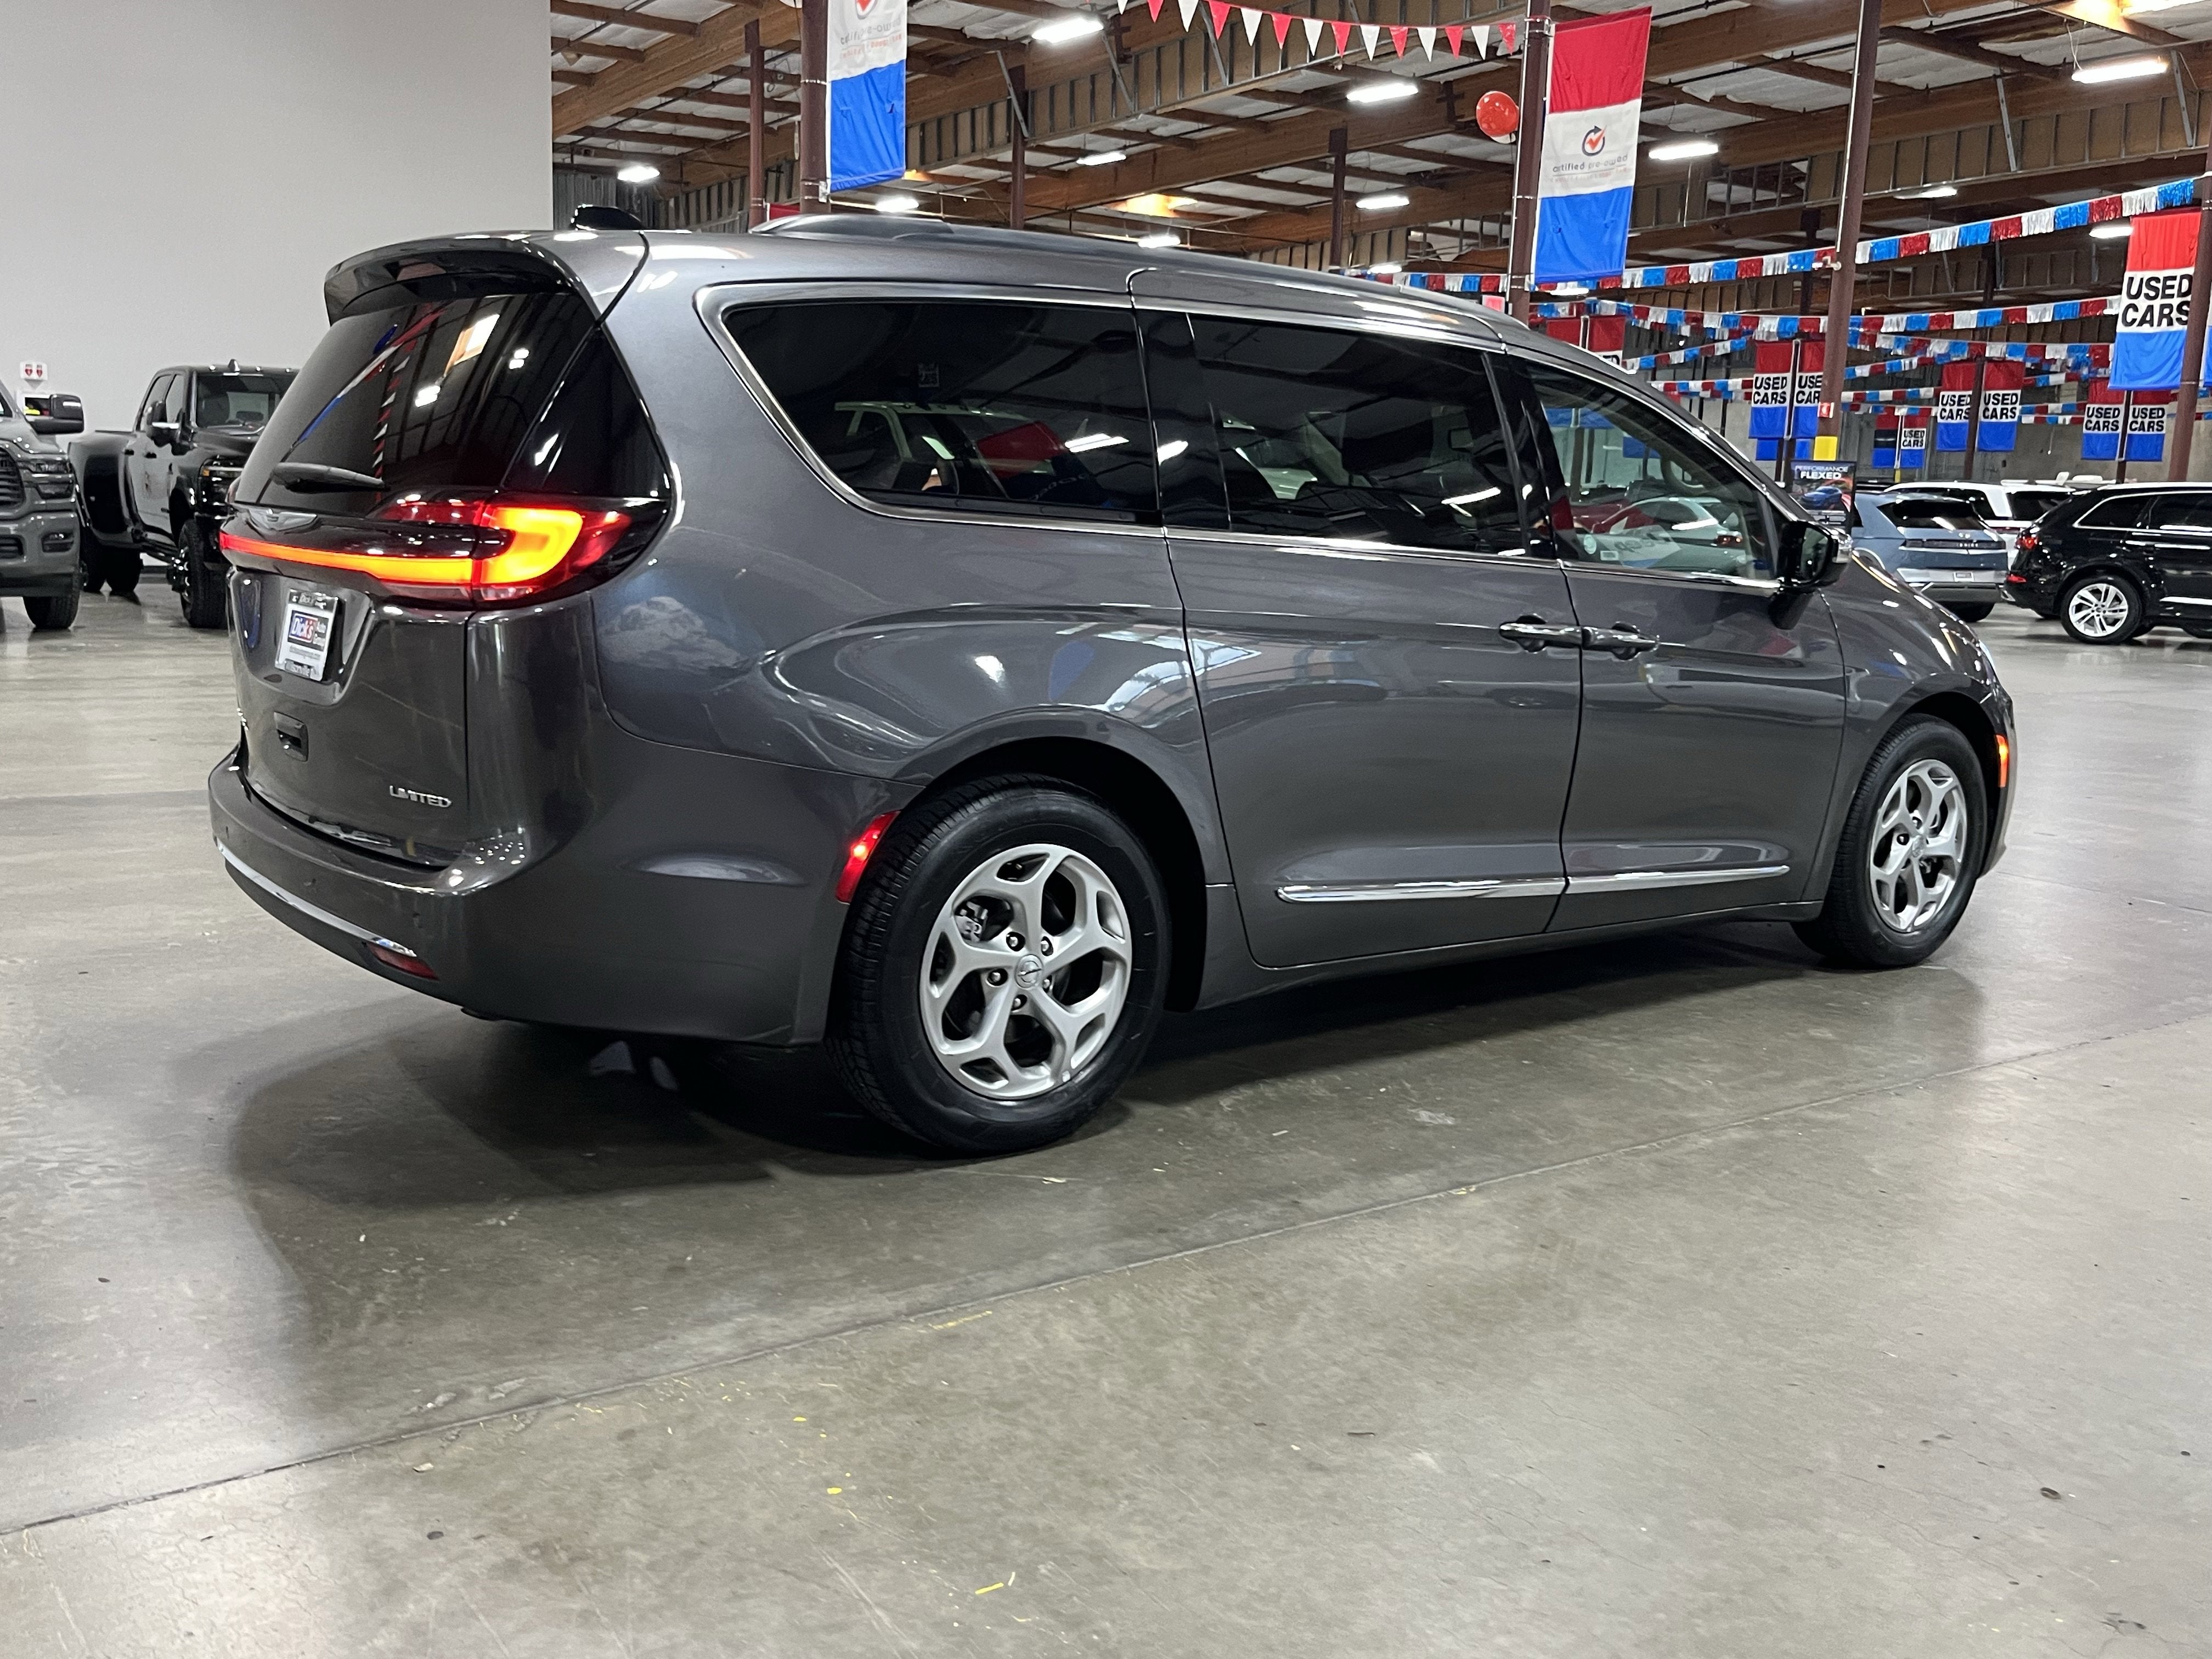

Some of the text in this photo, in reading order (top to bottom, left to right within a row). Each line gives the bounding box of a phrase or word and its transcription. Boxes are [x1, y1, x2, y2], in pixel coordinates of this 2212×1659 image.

[2126, 274, 2193, 301] USED
[2121, 301, 2191, 327] CARS
[1754, 376, 1787, 390] USED
[1798, 375, 1822, 388] USE
[1753, 391, 1787, 404] CARS
[1796, 390, 1820, 404] CAR
[1984, 393, 2019, 405] USED
[1982, 407, 2017, 420] CARS
[2086, 407, 2120, 419] USED
[2132, 407, 2165, 419] USED
[2085, 419, 2119, 432] CARS
[2129, 420, 2164, 432] CARS
[1904, 430, 1925, 438] USED
[1800, 471, 1842, 479] FLEXED
[390, 785, 452, 808] LIMITED
